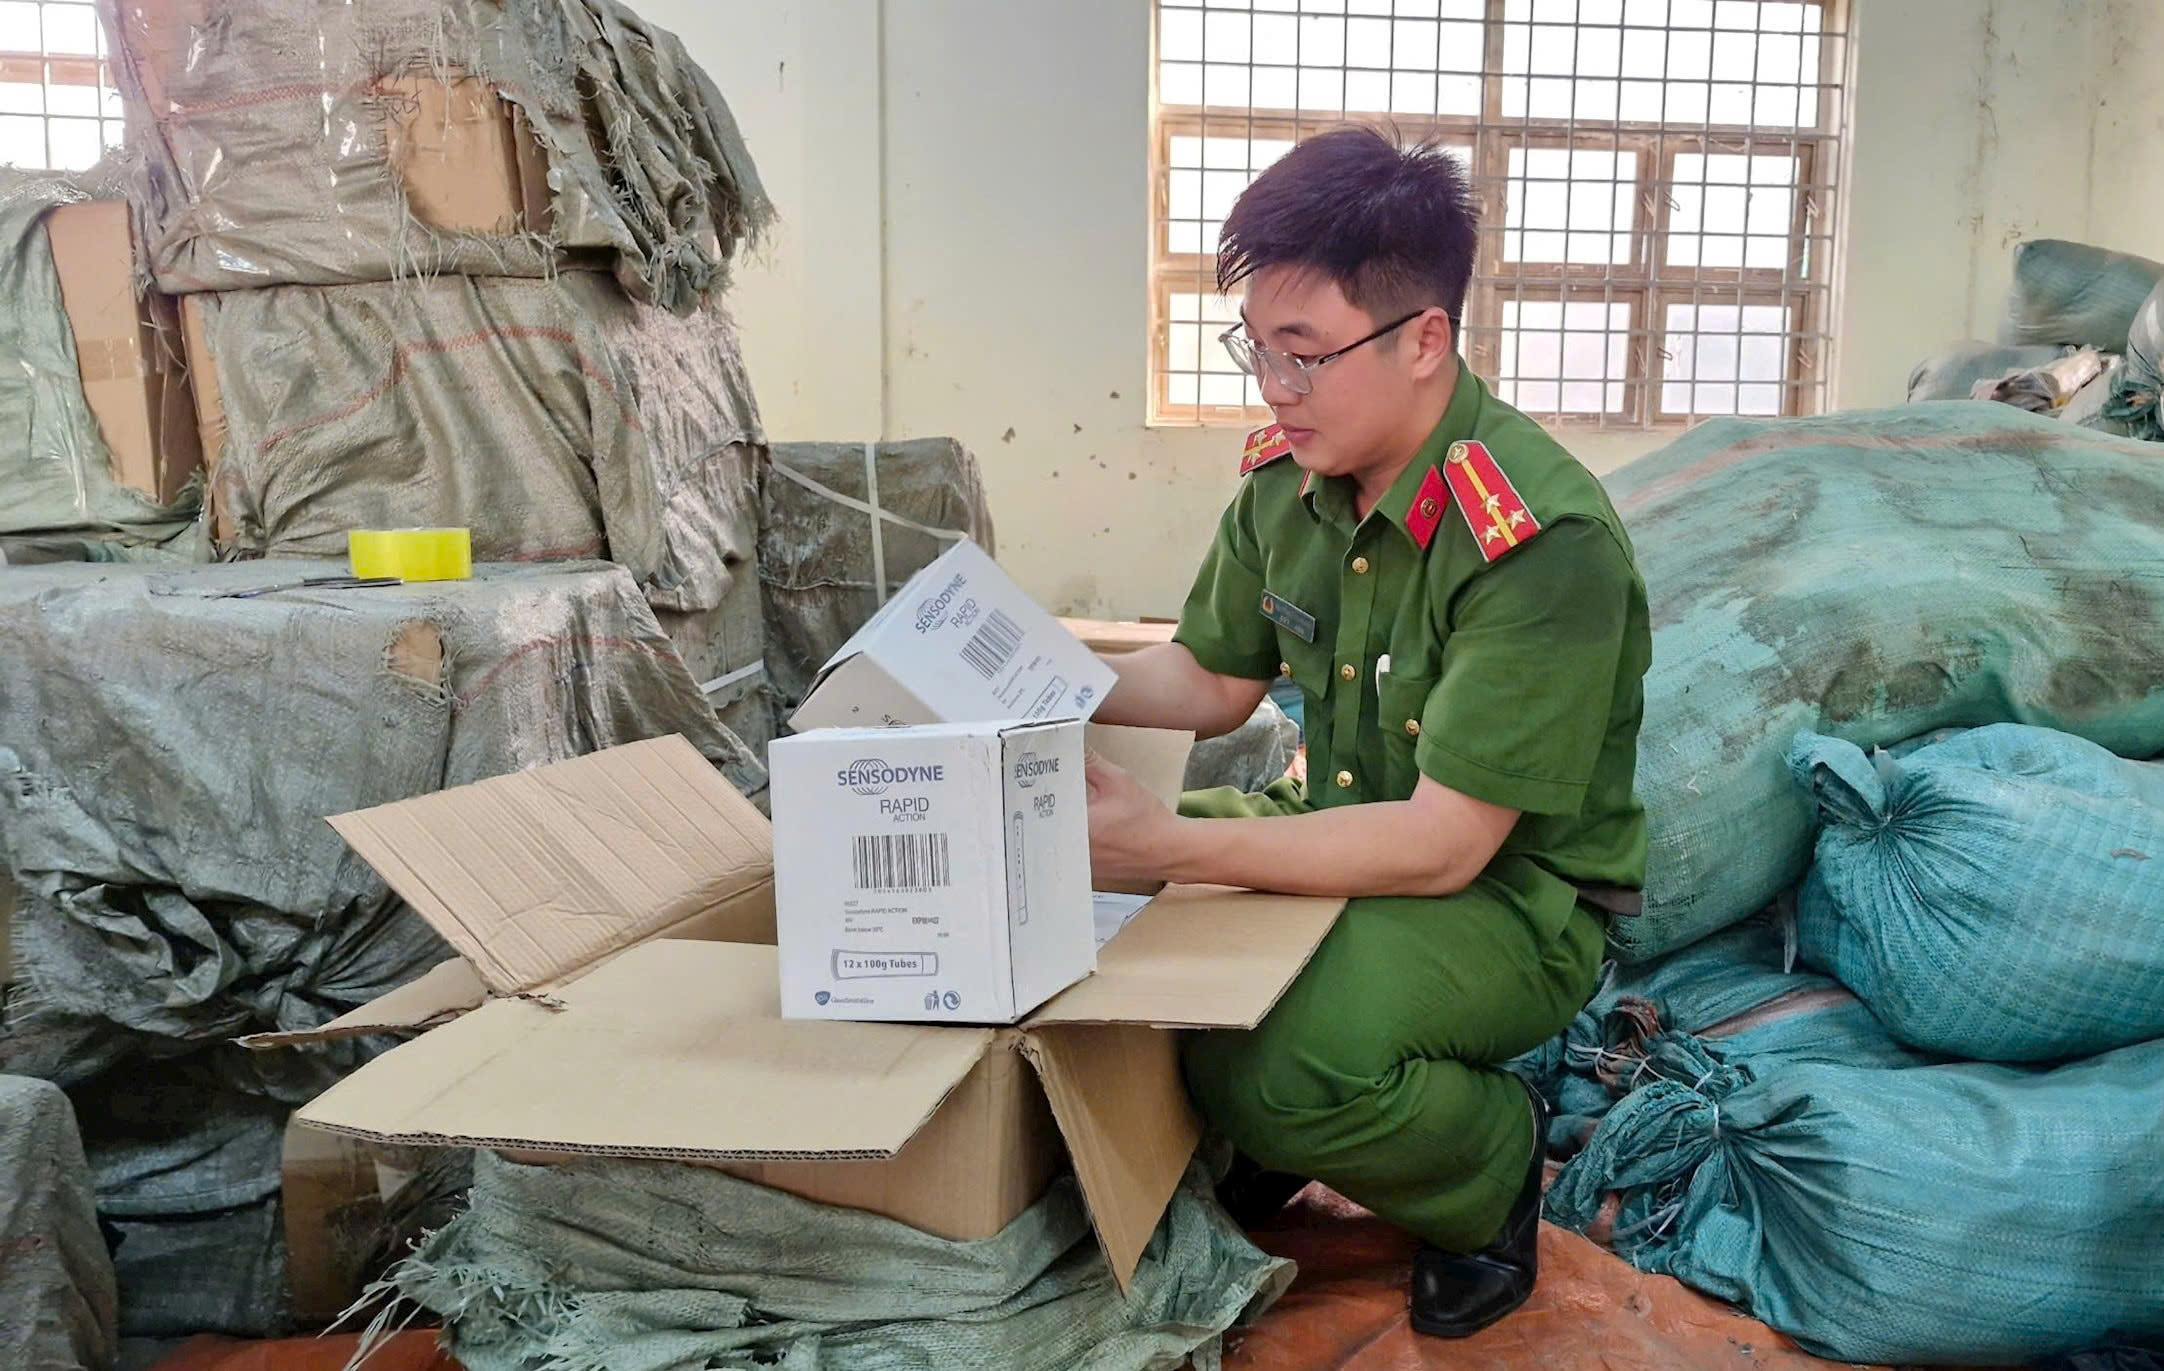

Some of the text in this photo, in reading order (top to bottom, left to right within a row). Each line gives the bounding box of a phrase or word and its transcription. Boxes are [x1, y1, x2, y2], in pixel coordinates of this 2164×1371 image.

[915, 573, 967, 634] SENSODYNE
[950, 598, 976, 629] RAPID
[837, 765, 944, 786] SENSODYNE
[880, 797, 930, 814] RAPID
[1033, 793, 1056, 811] RAPID
[893, 813, 926, 822] ACTION
[843, 959, 854, 969] 12
[864, 959, 887, 970] 100g
[889, 959, 917, 968] Tubes
